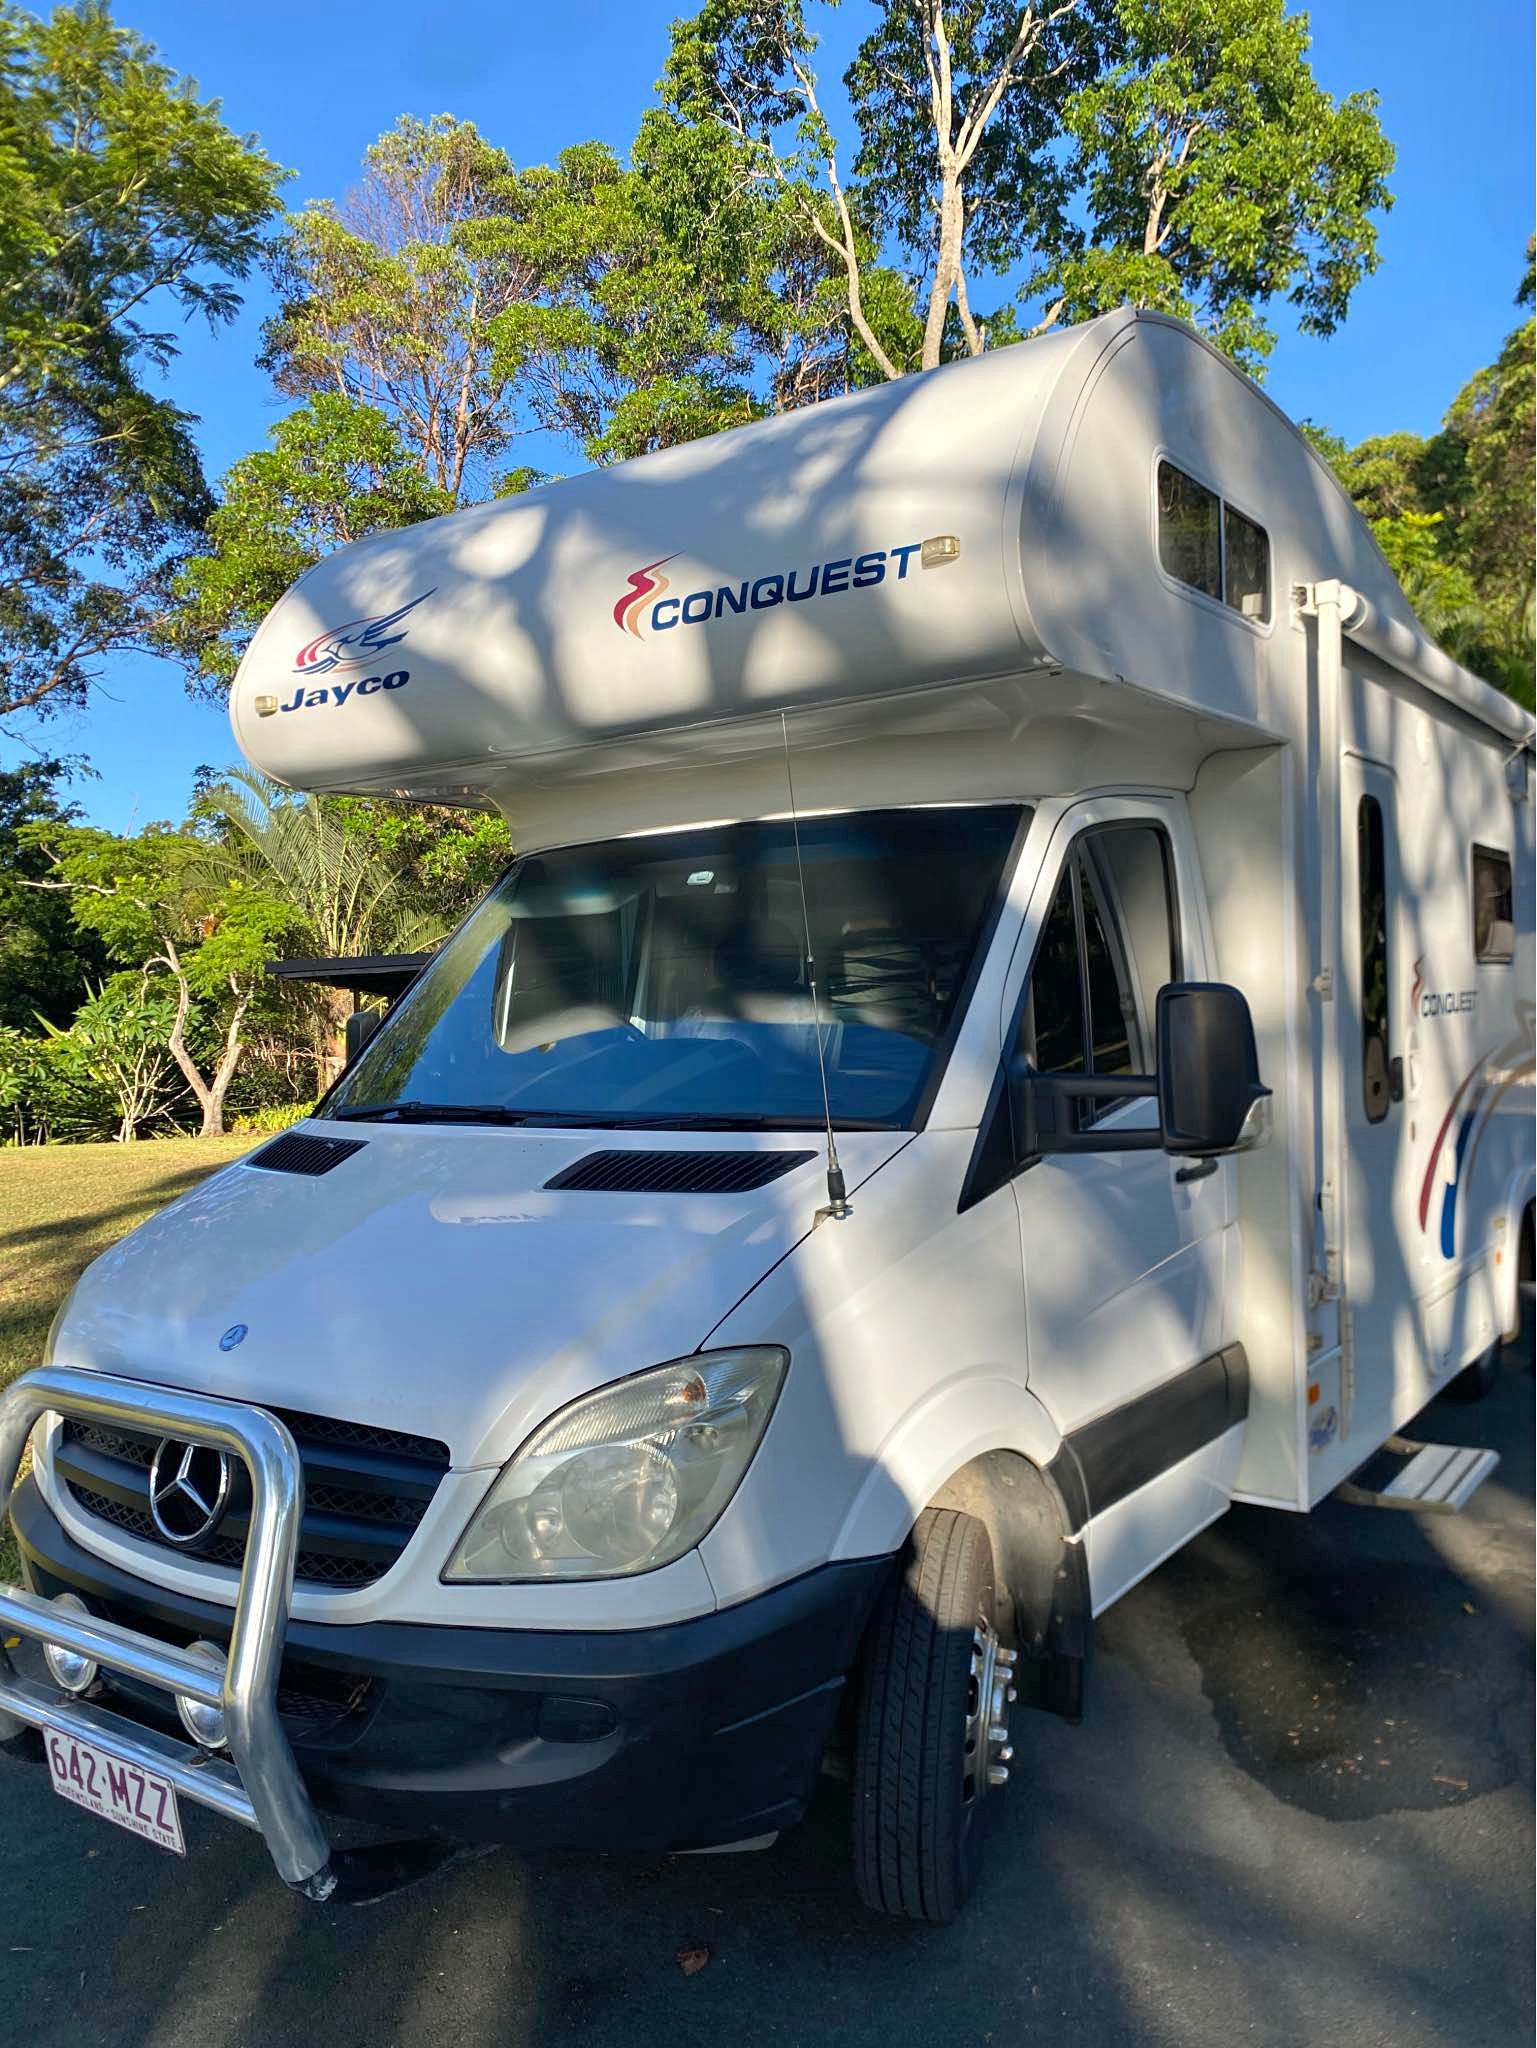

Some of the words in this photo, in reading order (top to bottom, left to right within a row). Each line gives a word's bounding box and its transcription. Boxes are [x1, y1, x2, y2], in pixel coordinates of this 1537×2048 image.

[651, 544, 922, 631] CONQUEST
[281, 670, 410, 712] Jayco
[152, 1828, 176, 1847] STATE
